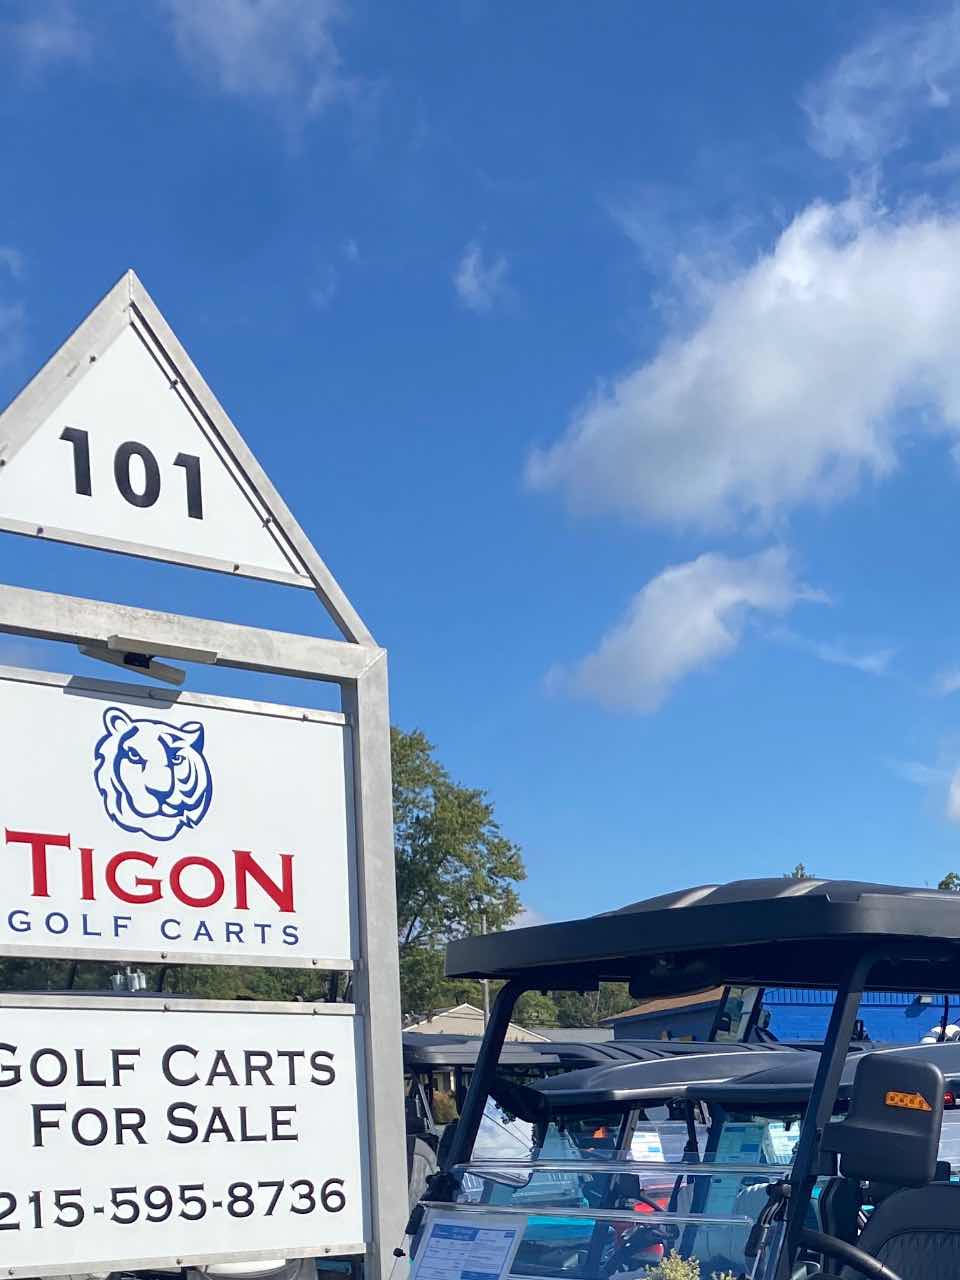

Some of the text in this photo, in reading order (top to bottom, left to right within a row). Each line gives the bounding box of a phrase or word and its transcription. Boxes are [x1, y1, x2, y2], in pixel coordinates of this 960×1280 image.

[59, 426, 204, 521] 101
[5, 827, 297, 914] TIGON
[7, 909, 300, 946] GOLF CARTS
[161, 1044, 336, 1087] CARTS
[30, 1101, 299, 1148] FOR SALE
[0, 1177, 347, 1231] 215-595-8736
